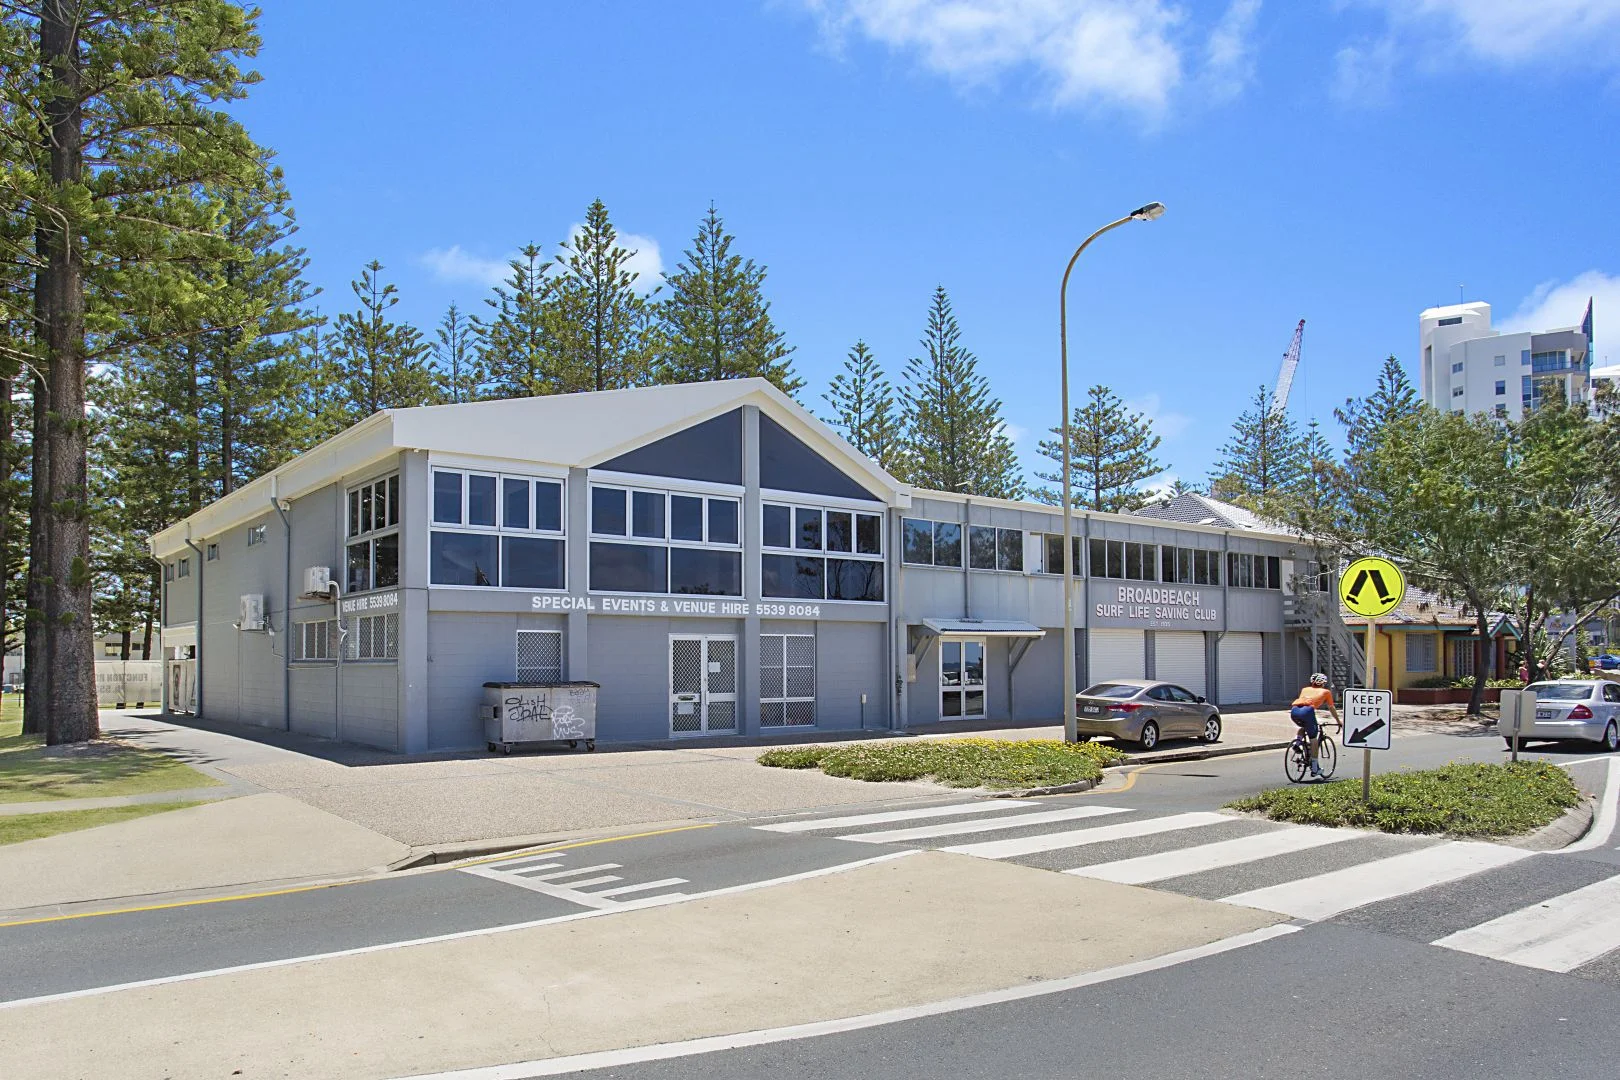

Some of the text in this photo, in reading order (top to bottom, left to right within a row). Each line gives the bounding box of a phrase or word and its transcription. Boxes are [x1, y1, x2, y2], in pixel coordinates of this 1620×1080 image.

[342, 592, 399, 613] VENUE HIRE 5539 8084
[1118, 586, 1200, 606] BROADBEACH
[532, 595, 820, 617] SPECIAL EVENTS & VENUE HIRE 5539 8084
[1096, 604, 1217, 621] SURF LIFE SAVING CLUB
[1352, 694, 1383, 704] KEEP
[1353, 707, 1381, 716] LEFT
